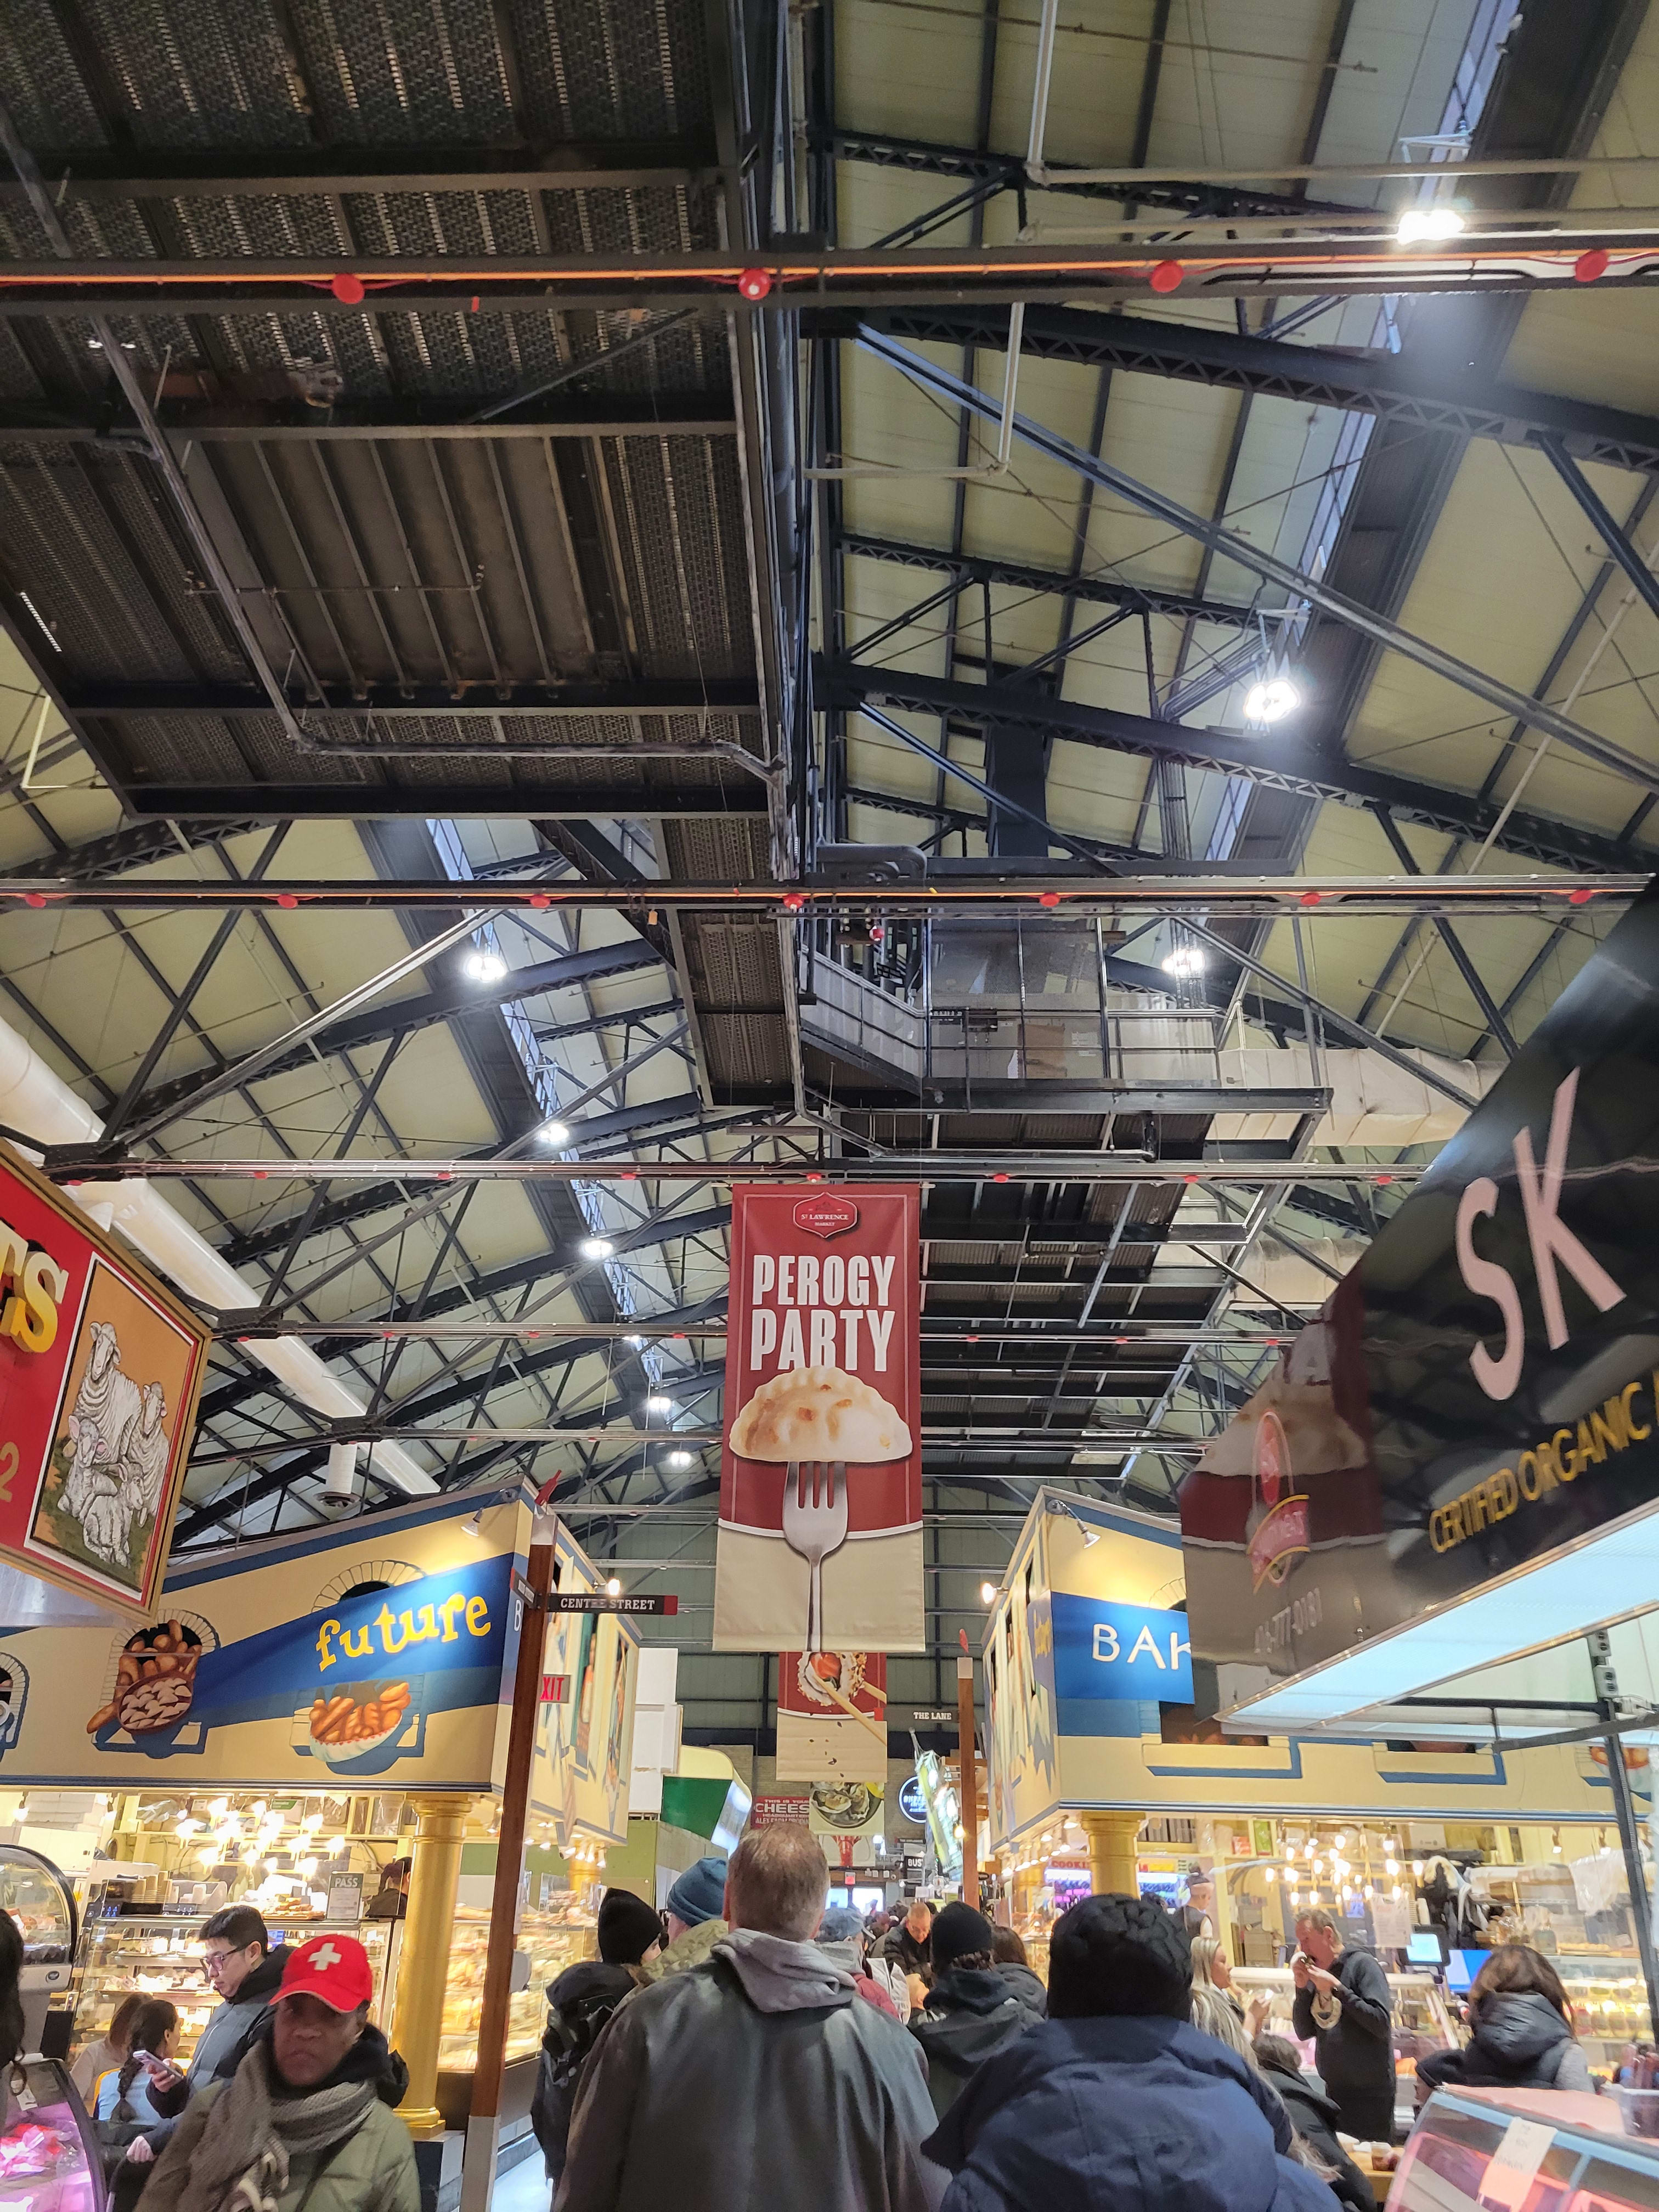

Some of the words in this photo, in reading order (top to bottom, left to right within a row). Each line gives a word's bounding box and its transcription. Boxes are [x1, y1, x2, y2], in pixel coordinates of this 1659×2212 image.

[752, 1255, 896, 1306] PEROGY
[750, 1310, 896, 1372] PARTY
[1429, 1468, 1519, 1554] CERTIFIED
[1517, 1381, 1652, 1501] ORGANIC
[611, 1599, 655, 1610] STREET
[315, 1591, 491, 1672] future
[335, 1877, 358, 1887] PASS
[907, 1858, 924, 1867] BUS
